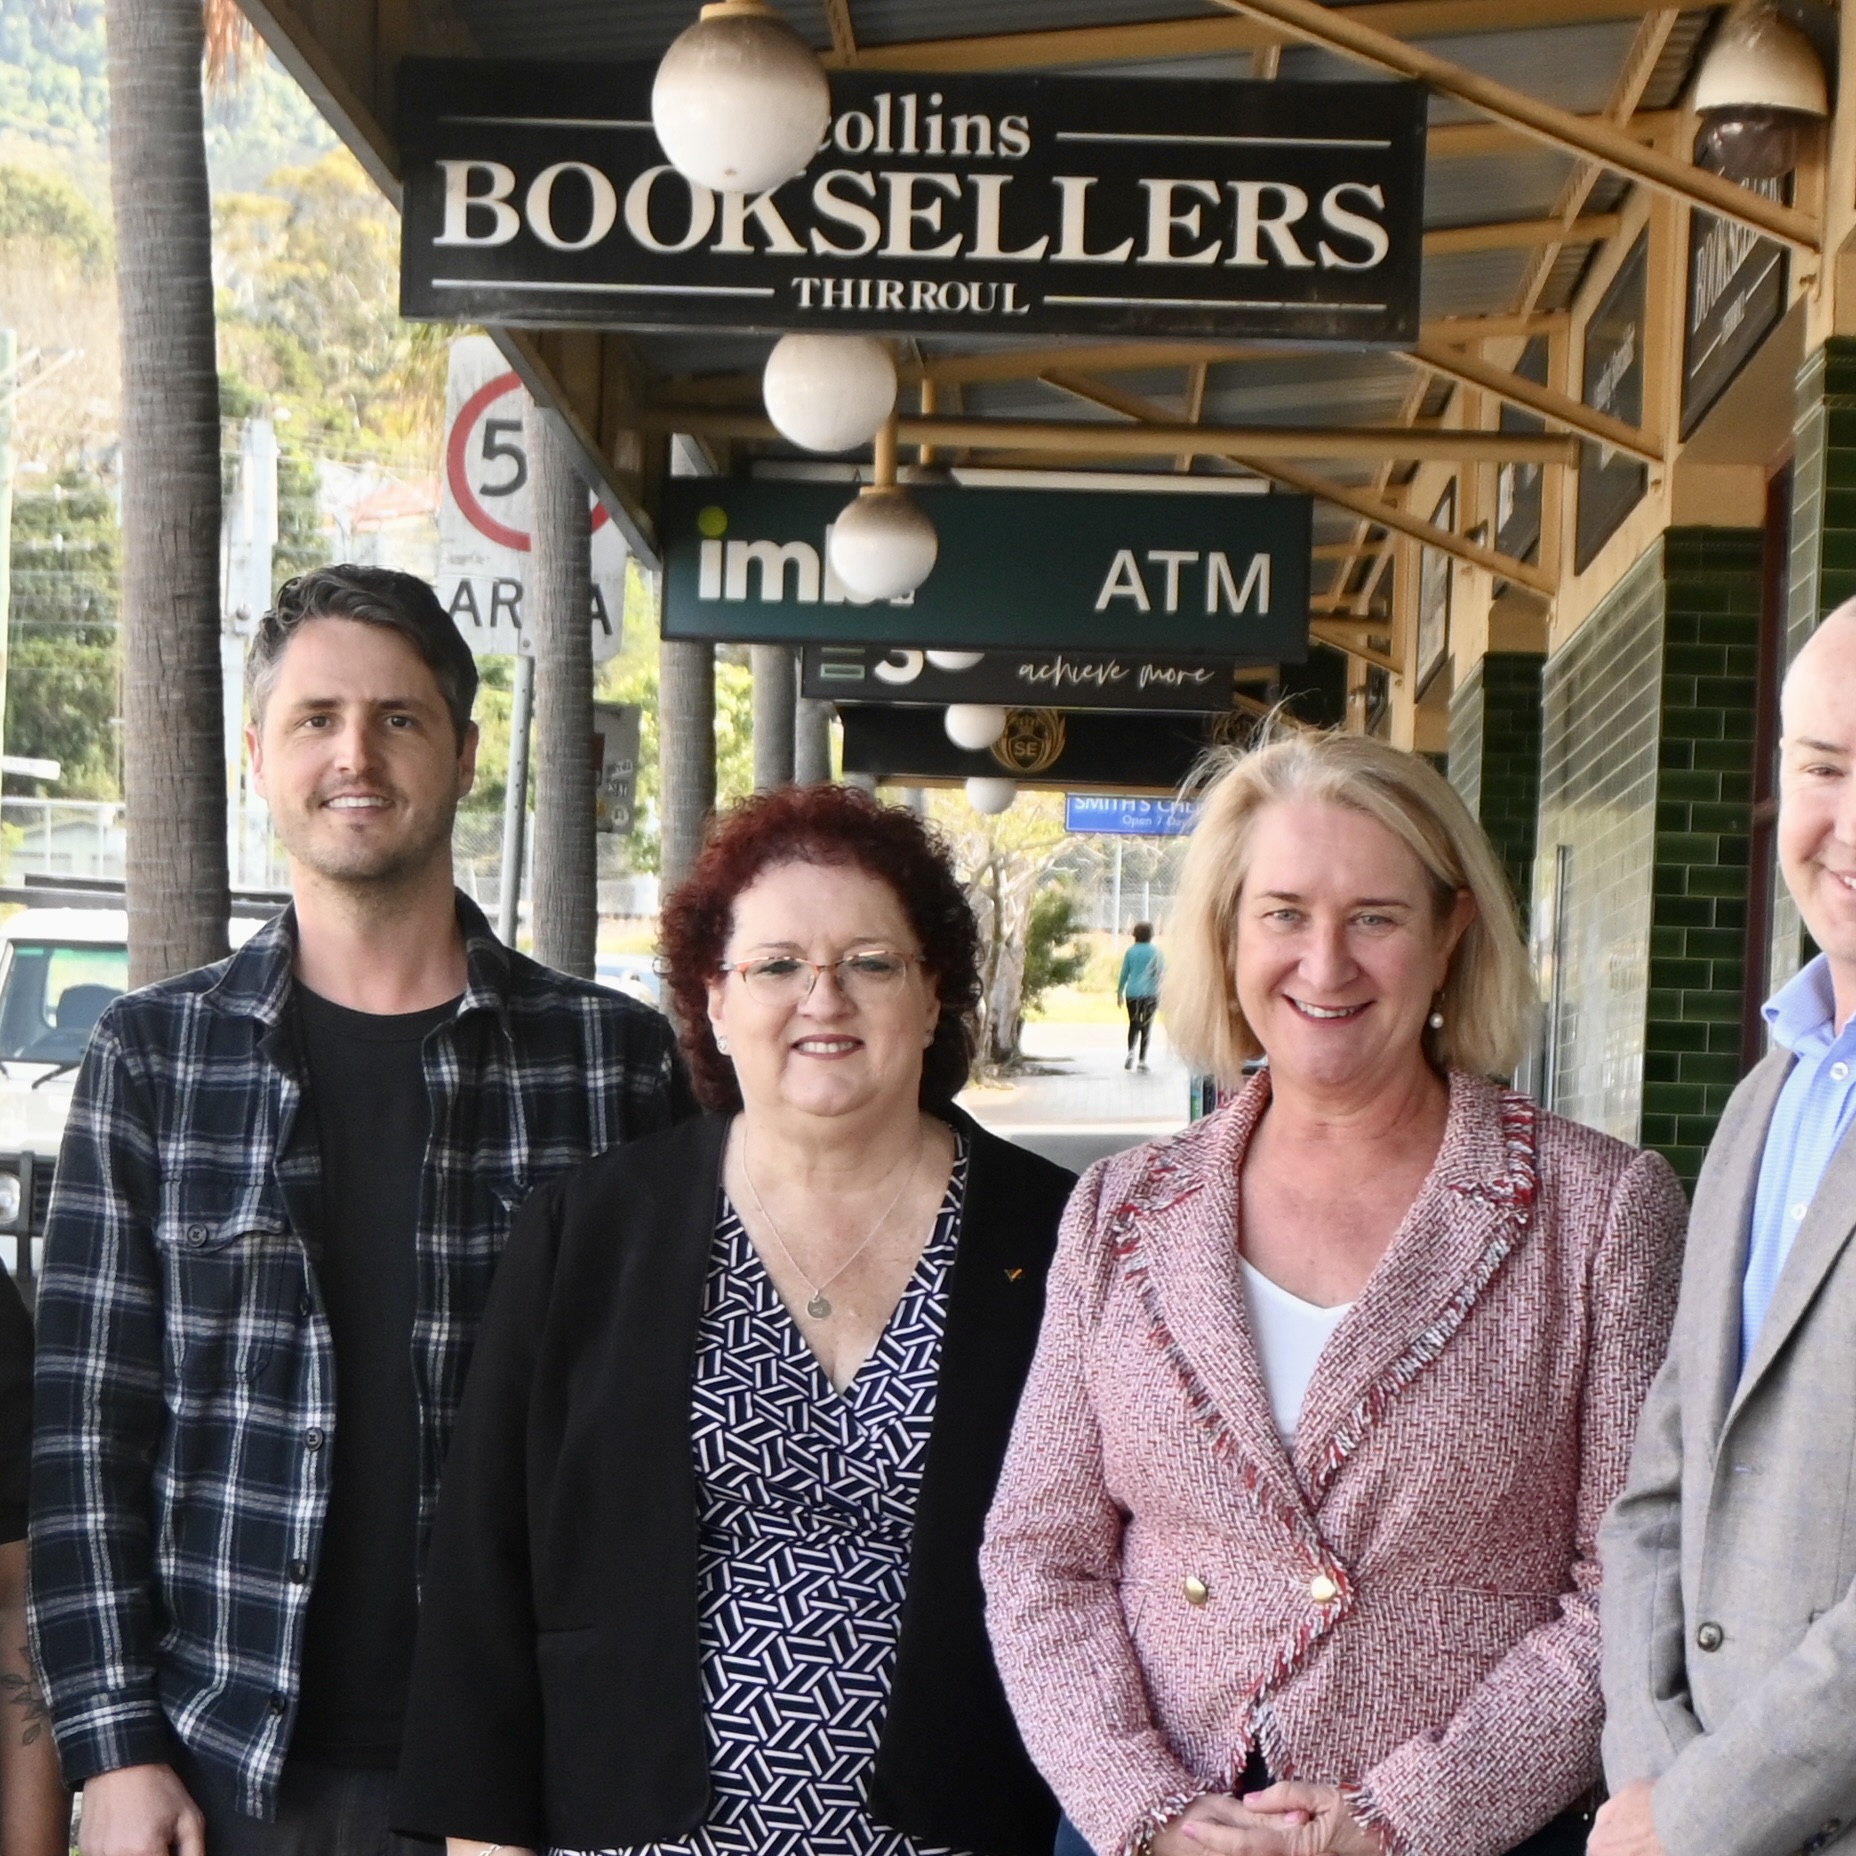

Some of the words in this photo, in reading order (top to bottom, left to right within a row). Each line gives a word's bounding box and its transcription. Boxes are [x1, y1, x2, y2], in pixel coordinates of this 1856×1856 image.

[817, 91, 1031, 156] ollins
[432, 160, 1391, 269] BOOKSELLERS
[791, 276, 1031, 315] THIRROUL
[478, 418, 529, 498] 5
[1094, 548, 1272, 615] ATM
[448, 577, 613, 636] ARA
[1018, 655, 1130, 687] achieve
[1139, 663, 1215, 689] more
[1014, 741, 1038, 757] SE
[1074, 797, 1152, 812] SMITHS
[1122, 814, 1153, 828] Open
